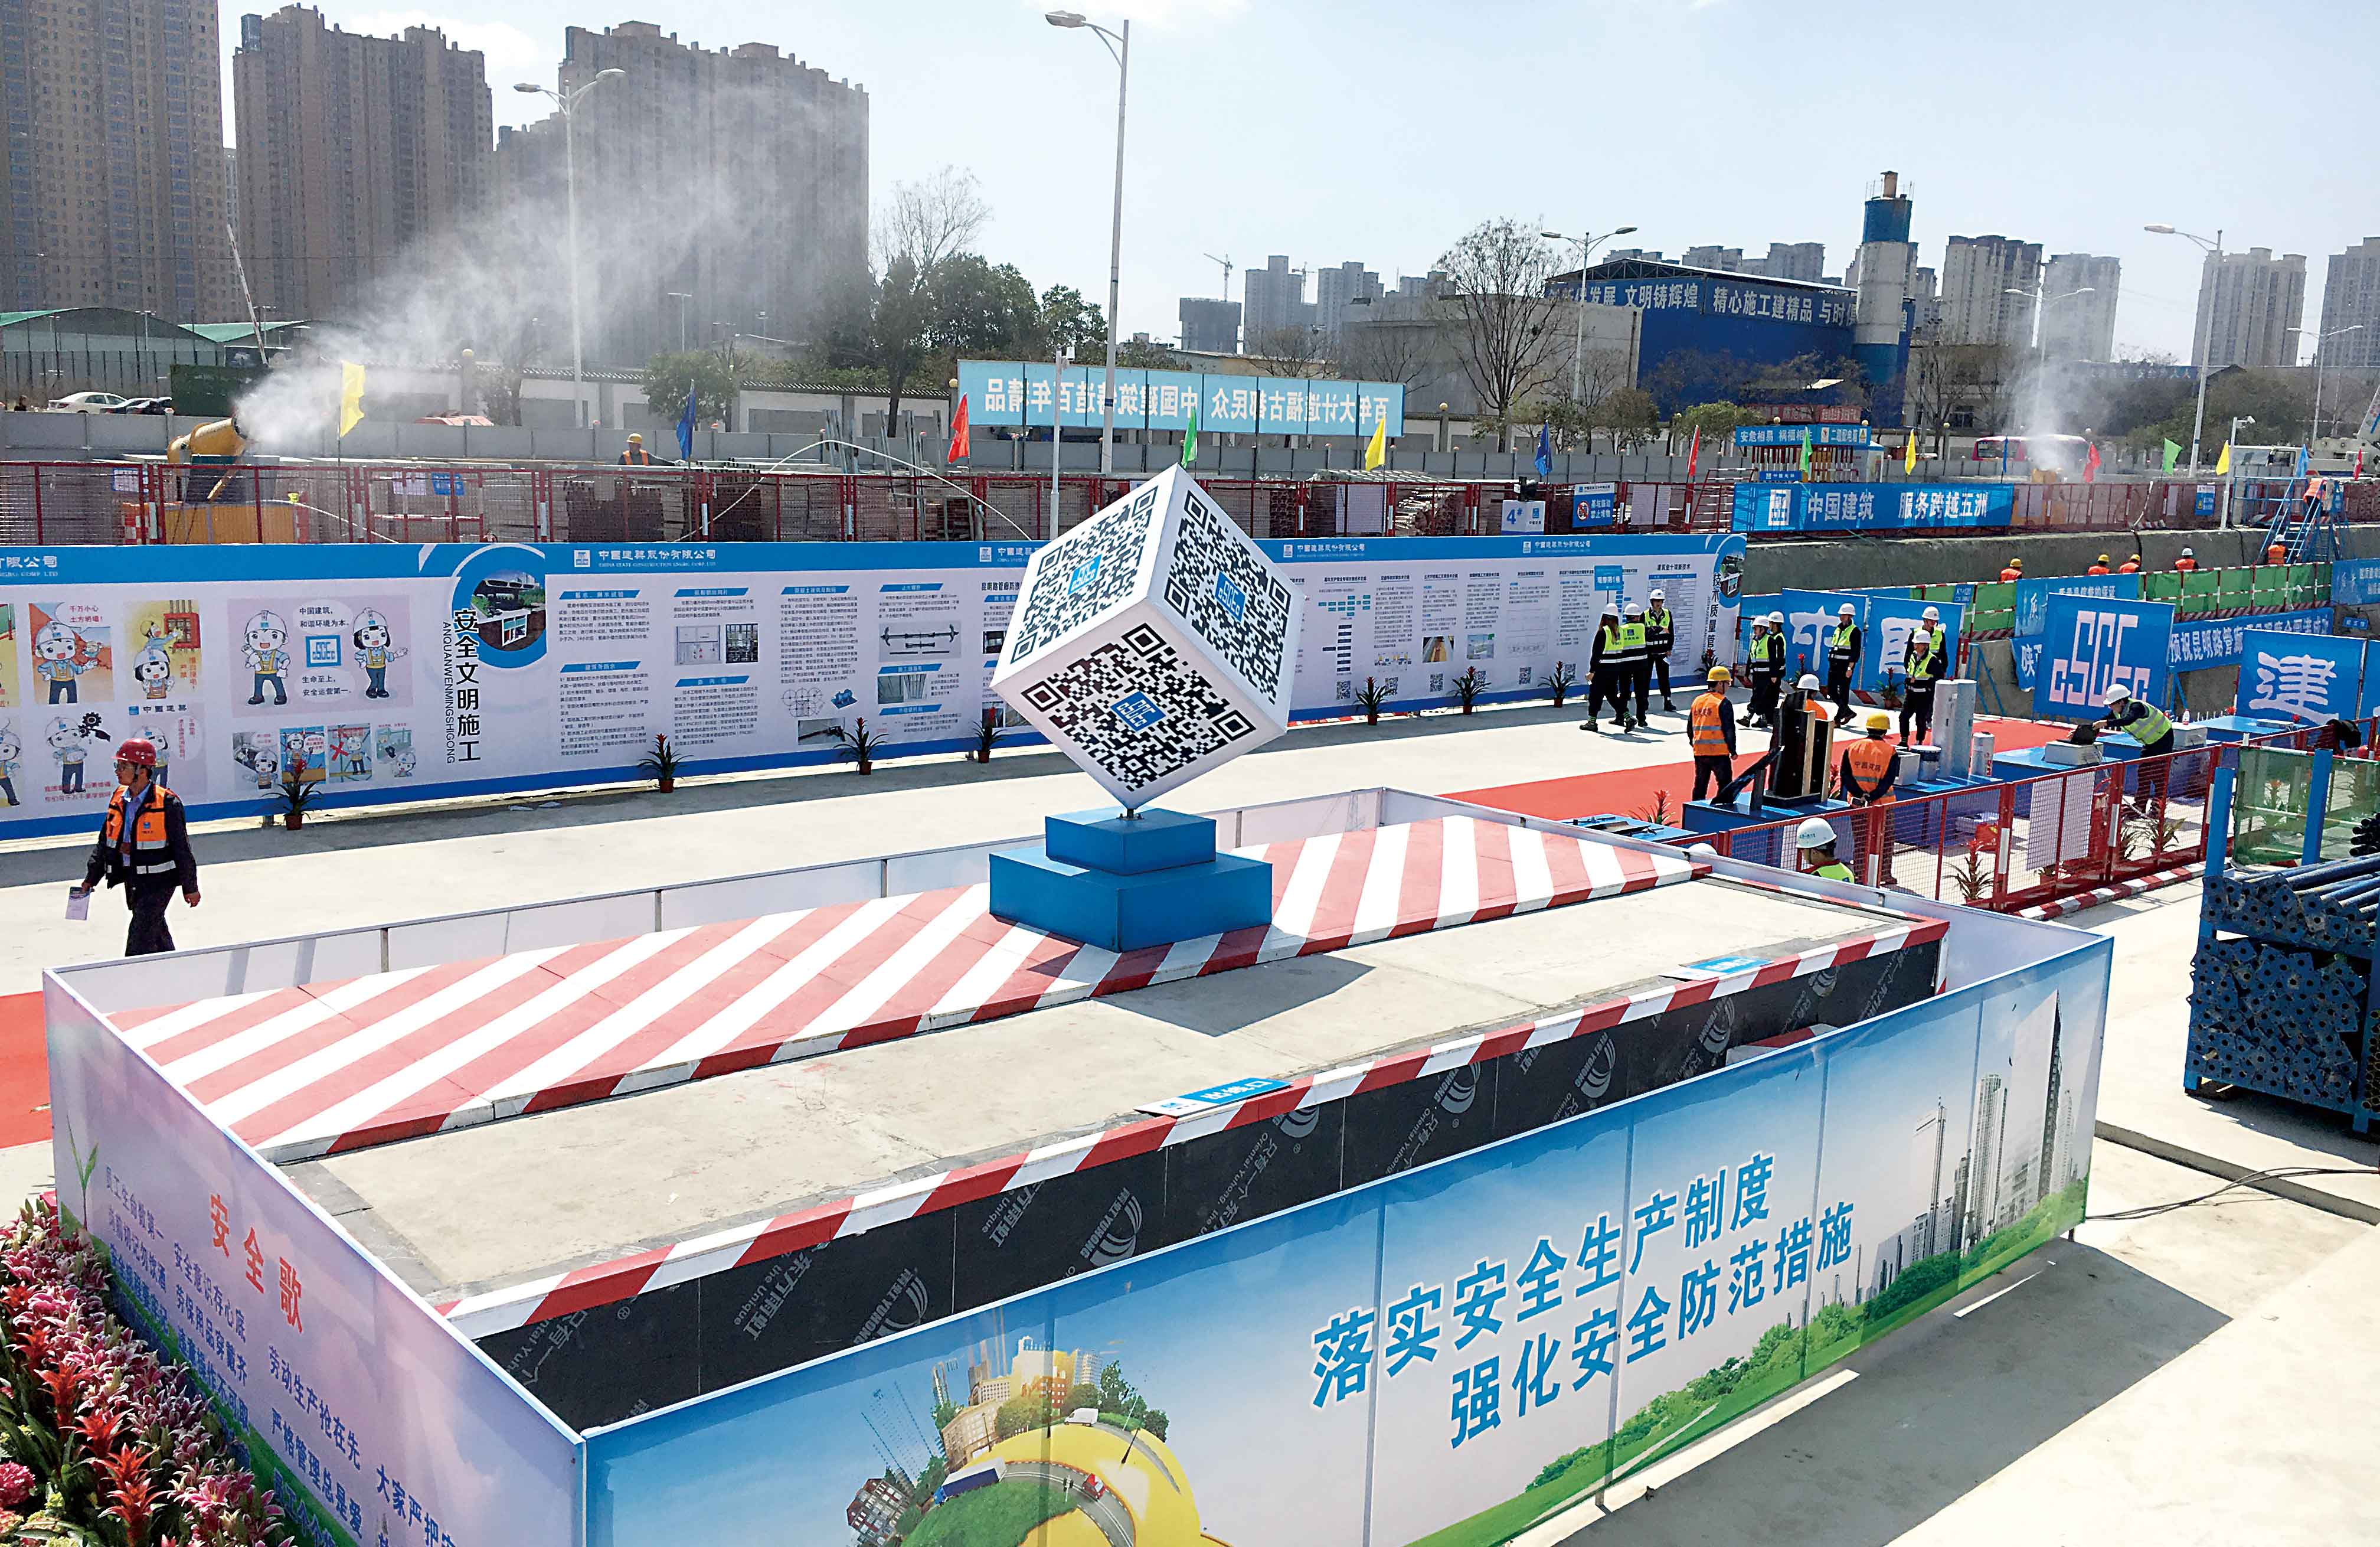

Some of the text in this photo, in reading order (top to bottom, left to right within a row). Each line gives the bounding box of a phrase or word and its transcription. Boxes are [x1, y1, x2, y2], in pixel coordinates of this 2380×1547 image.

[1626, 283, 1698, 311] 文明铸辉煌
[1713, 285, 1812, 323] 精心施工建精品
[1808, 491, 1987, 521] 中国建筑 服务跨越五洲
[0, 556, 57, 568] 限公司
[1706, 572, 1721, 660] 技术质量管
[443, 622, 455, 763] ANQUANWENMINGSHIGONG
[453, 609, 480, 763] 安全文明施工
[1238, 1138, 1278, 1200] 只有一个
[1243, 1132, 1269, 1169] Oriental
[982, 1197, 1010, 1233] Unique
[1080, 1214, 1115, 1259] YUHONG
[174, 1242, 246, 1343] 安全意识存心底
[210, 1193, 303, 1334] 安全歌
[733, 1284, 768, 1326] Unique
[743, 1251, 813, 1341] 东方雨虹
[1312, 1152, 1776, 1409] 落实安全生产制度
[176, 1284, 247, 1387] 劳保用品穿戴齐
[1449, 1200, 1855, 1448] 强化安全防范措施
[269, 1346, 361, 1470] 劳动生产抢在先
[272, 1408, 362, 1539] 严格管理总是爱
